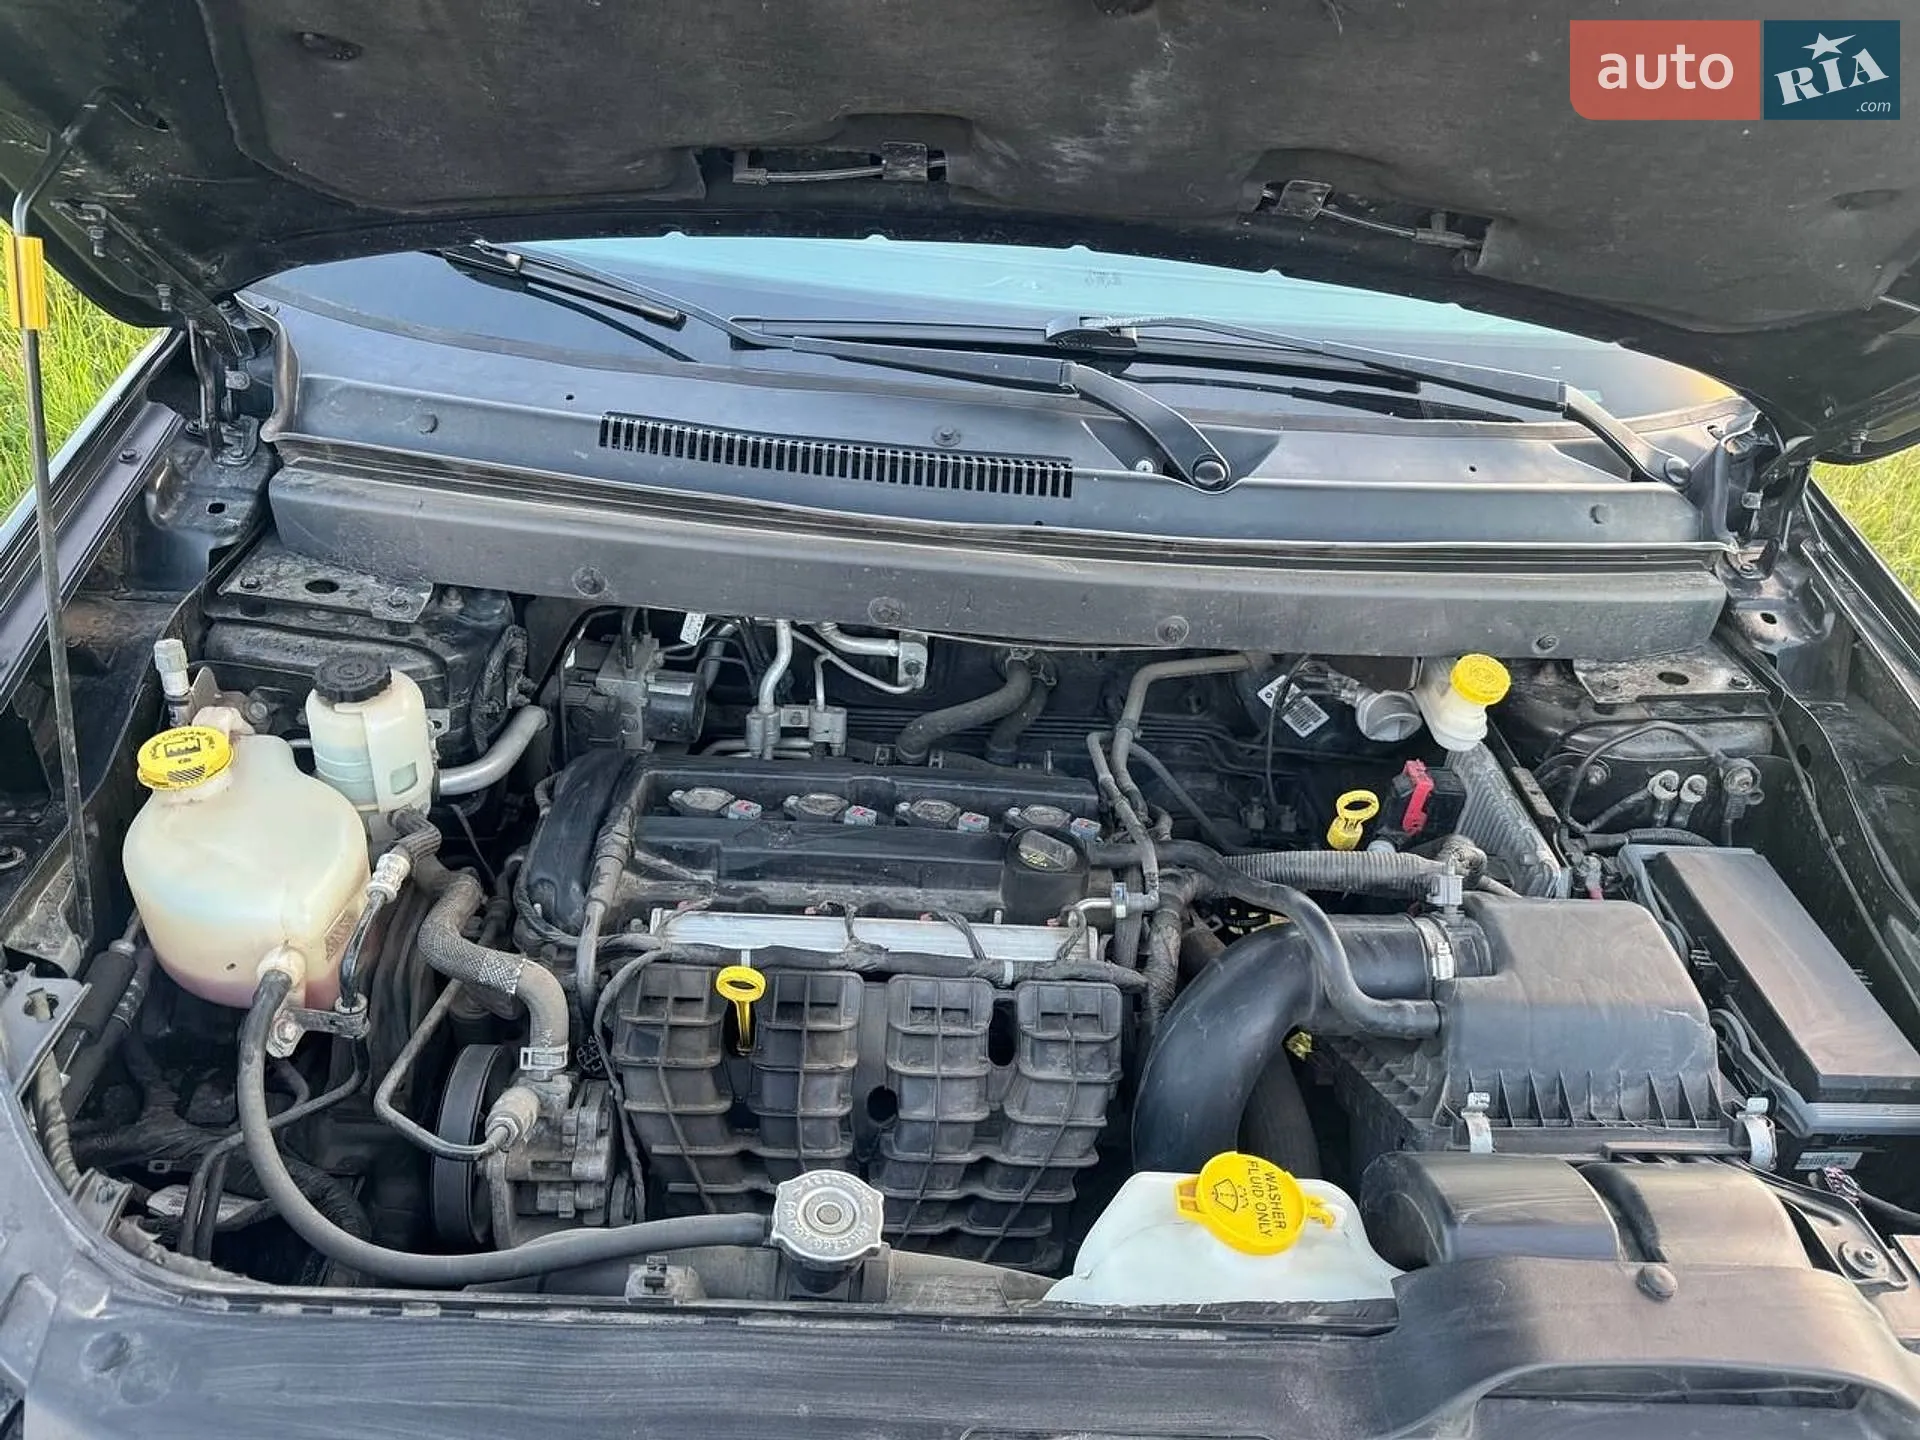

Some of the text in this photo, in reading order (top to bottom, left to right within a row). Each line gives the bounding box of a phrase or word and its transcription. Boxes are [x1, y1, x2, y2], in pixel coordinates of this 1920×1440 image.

[1247, 1160, 1273, 1238] FLUID ONLY
[1264, 1171, 1287, 1230] WASHER
